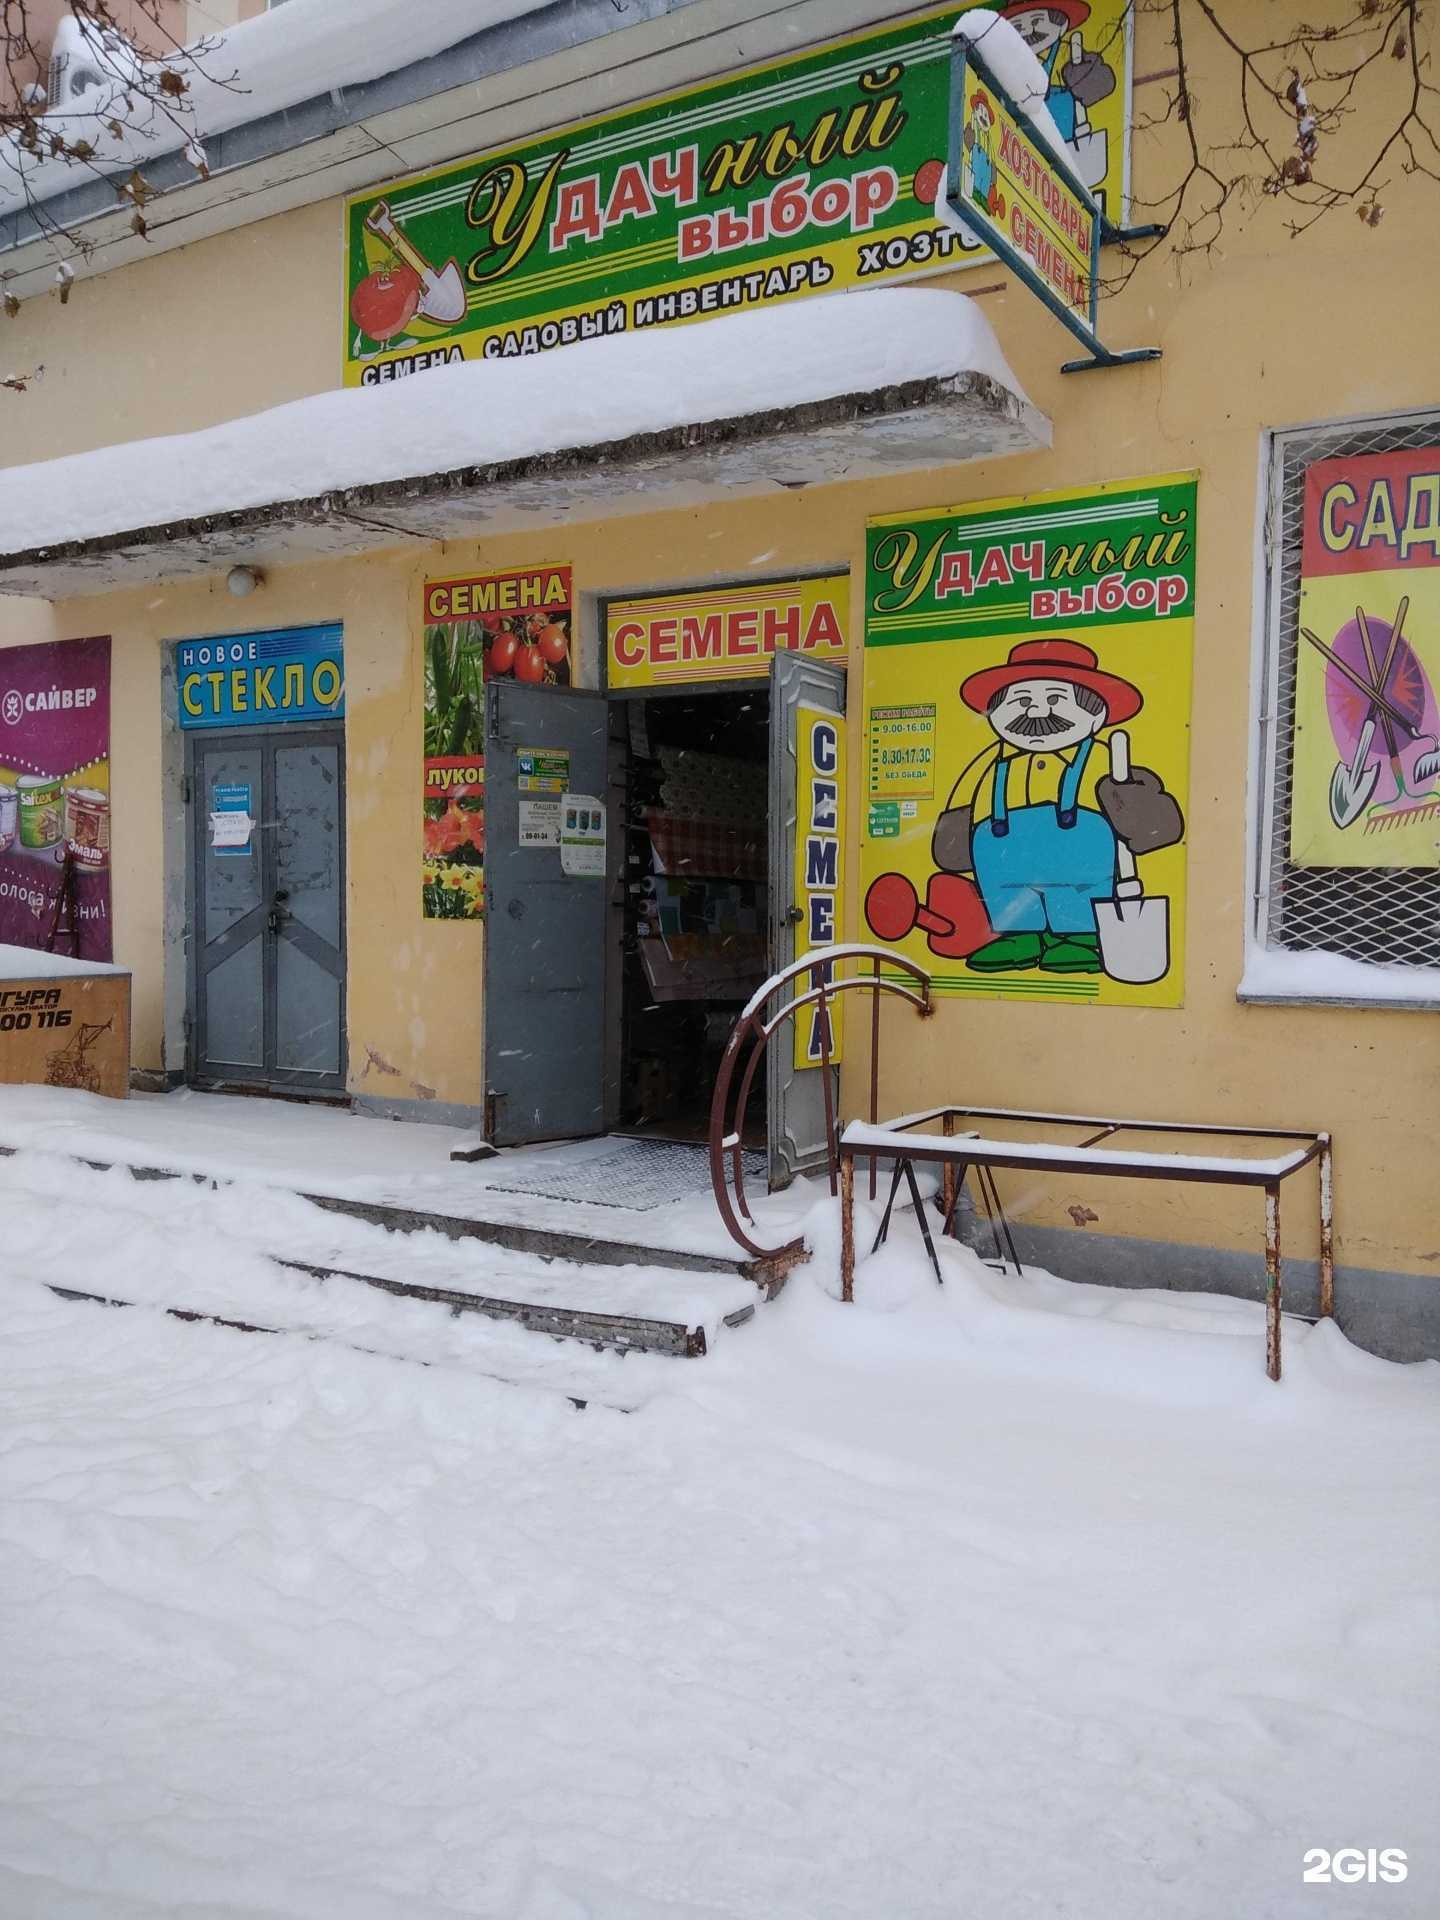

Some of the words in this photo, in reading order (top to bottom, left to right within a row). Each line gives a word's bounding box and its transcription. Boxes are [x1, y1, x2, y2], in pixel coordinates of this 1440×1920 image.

[999, 119, 1089, 256] ХОЗТОВАРЫ
[1010, 202, 1089, 314] СЕМЕНА
[483, 304, 625, 359] САДОВЫЙ
[634, 257, 833, 327] ИНВЕНТАРЬ
[428, 574, 567, 617] СЕМЕНА
[183, 641, 257, 665] НОВОЕ
[613, 601, 844, 667] СЕМЕНА
[25, 685, 97, 712] САЙВЕР
[183, 660, 341, 716] СТЕКЛО
[0, 989, 61, 1006] ГУРА
